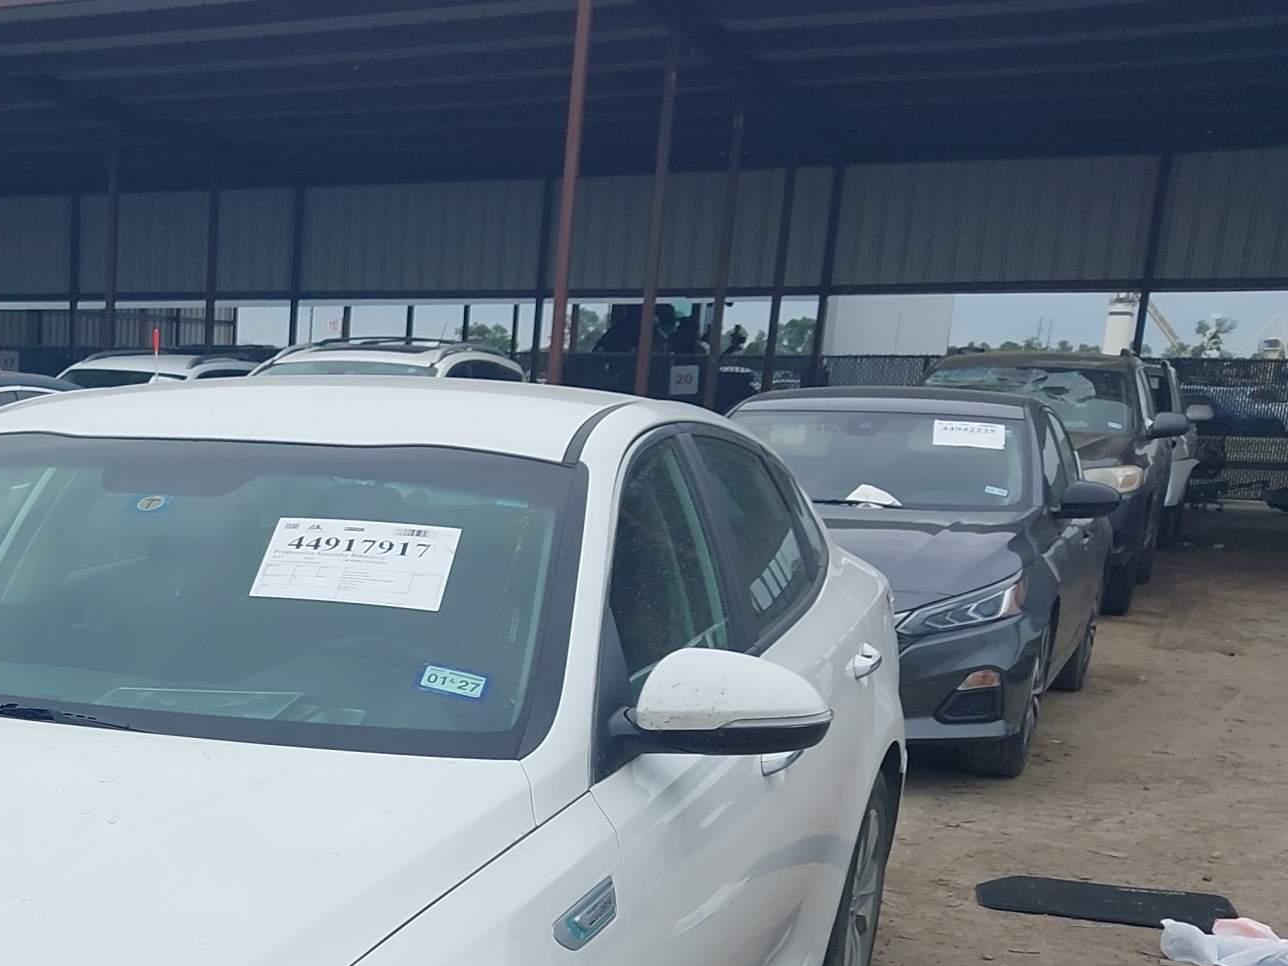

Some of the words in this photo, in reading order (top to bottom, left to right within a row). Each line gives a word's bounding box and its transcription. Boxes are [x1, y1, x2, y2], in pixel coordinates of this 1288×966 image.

[675, 373, 694, 385] 20
[287, 535, 431, 559] 44917917
[427, 673, 448, 686] 01
[457, 680, 481, 693] 27
